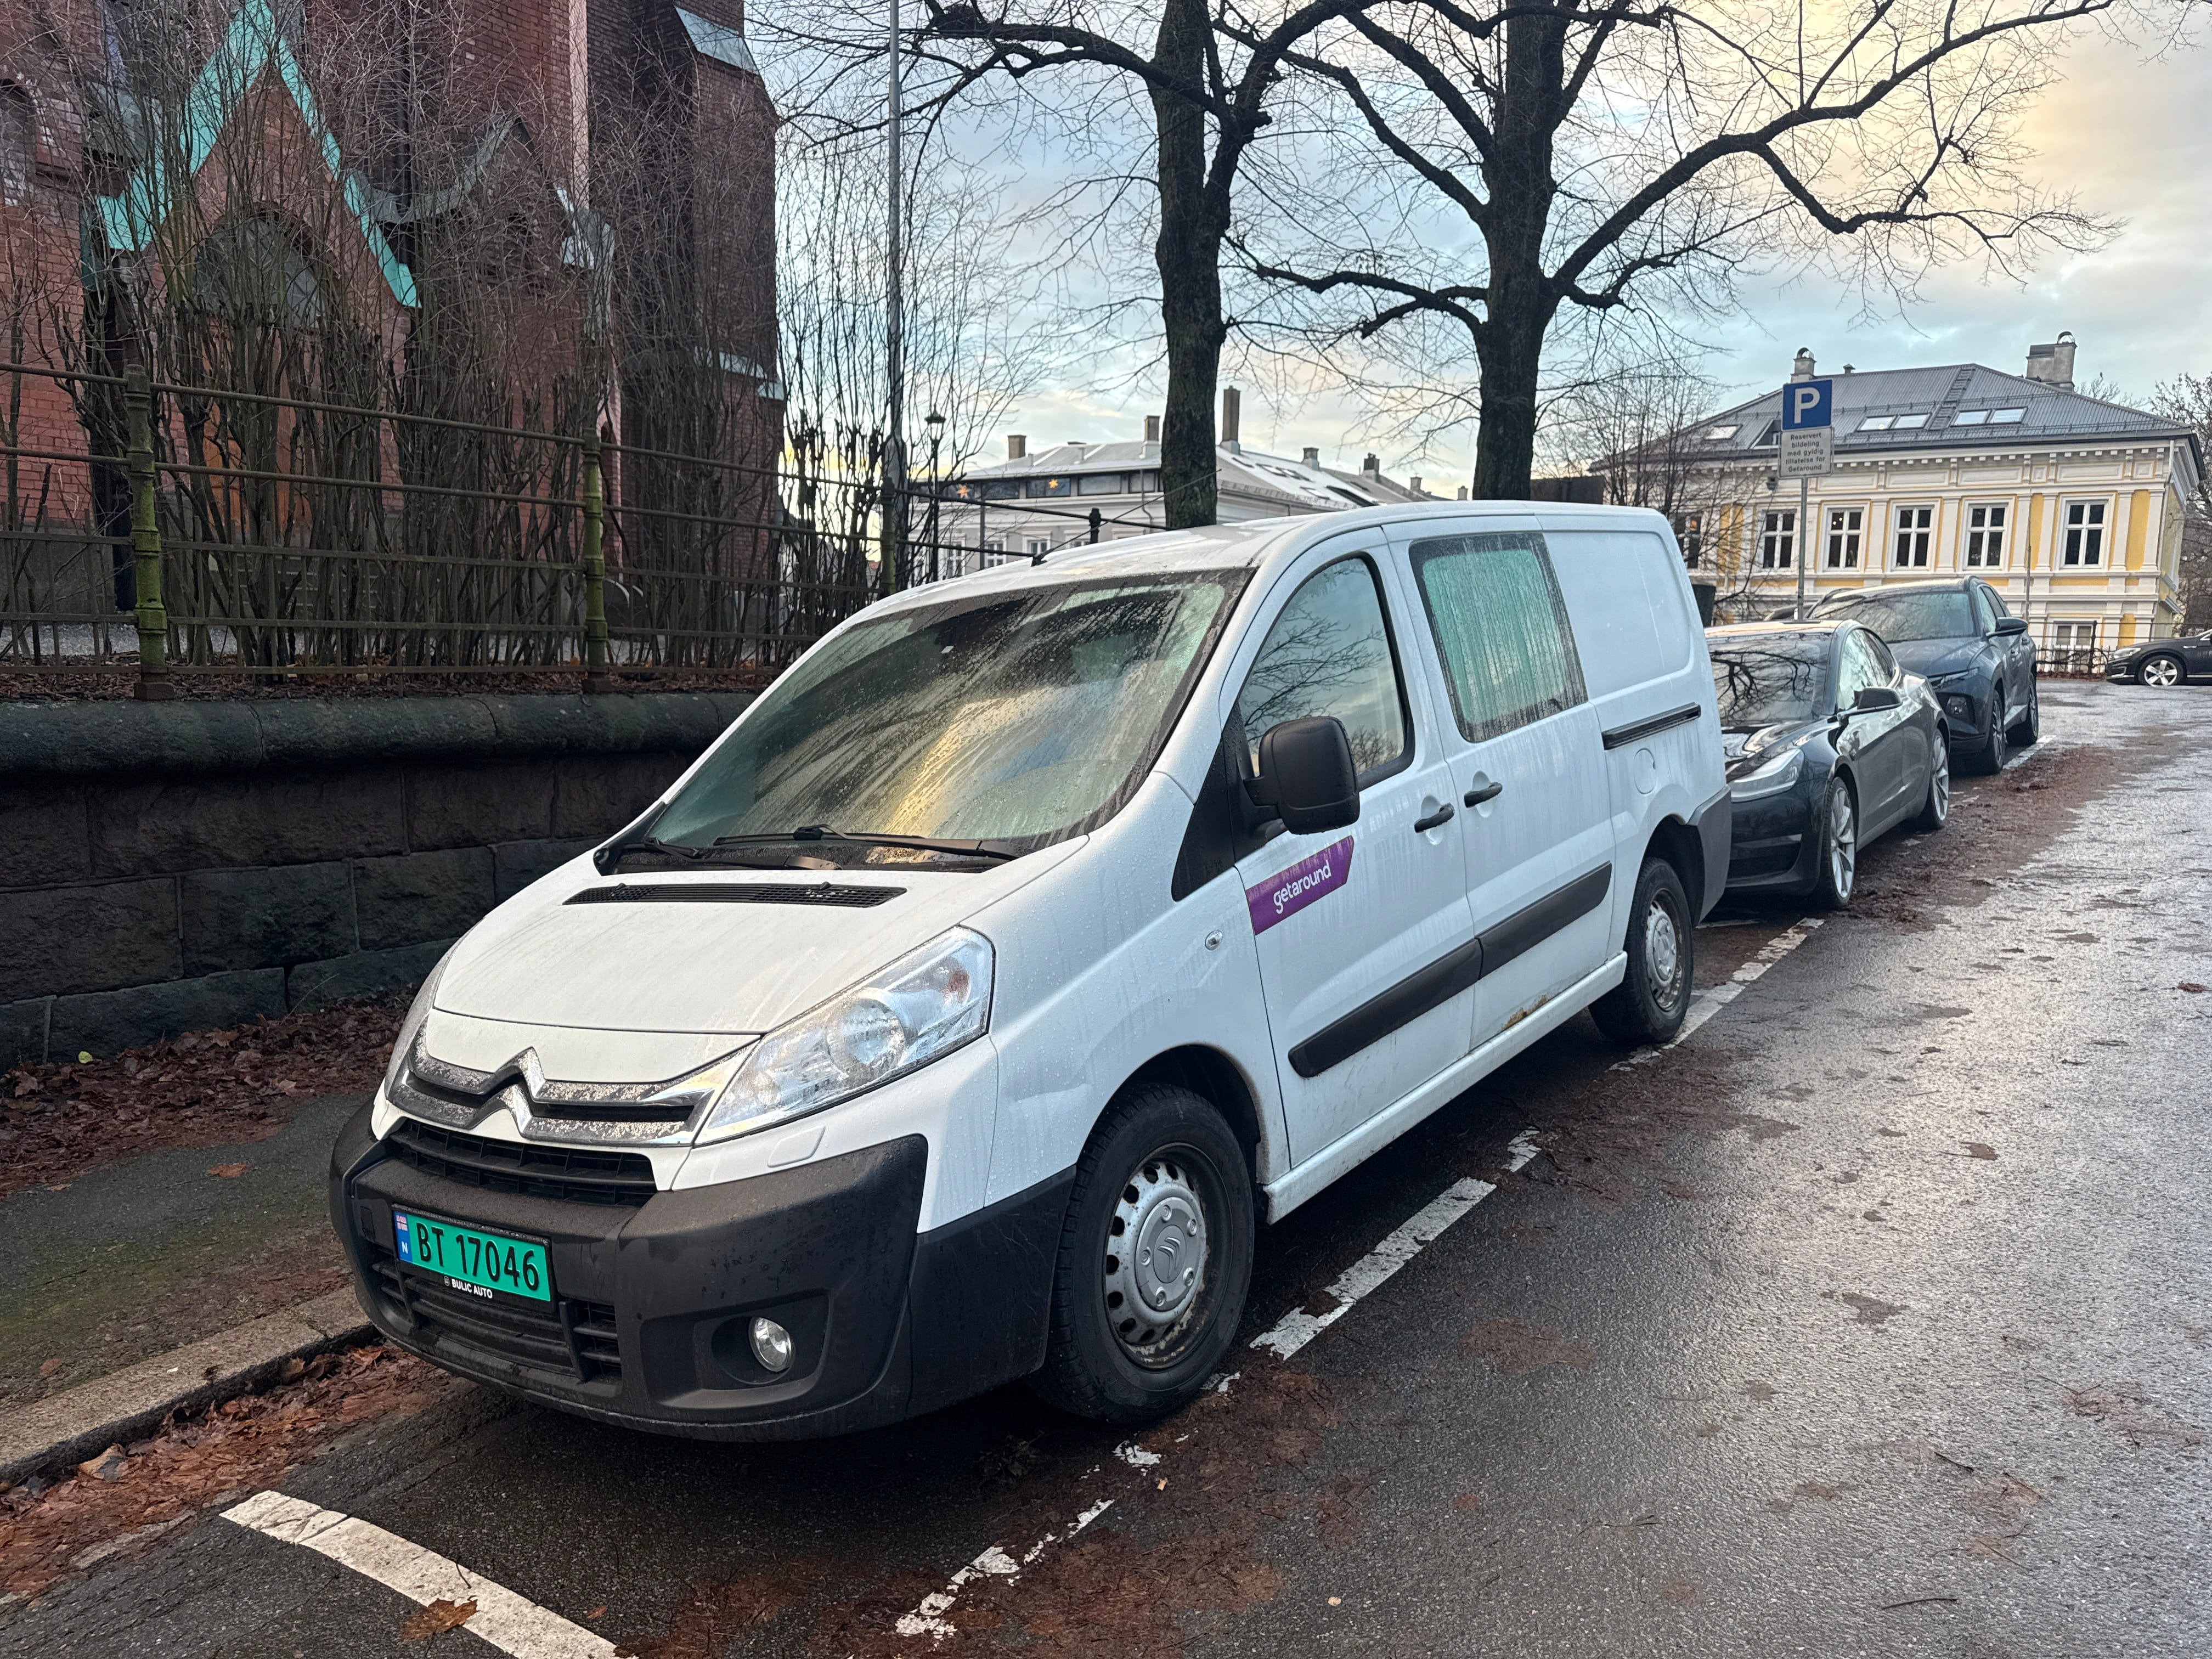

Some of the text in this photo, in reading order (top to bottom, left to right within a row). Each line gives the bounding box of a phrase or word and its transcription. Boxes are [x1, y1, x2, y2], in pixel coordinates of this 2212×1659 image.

[1794, 387, 1820, 424] P
[1791, 432, 1821, 441] Reservert
[1788, 464, 1821, 472] Getaround
[1273, 860, 1331, 914] getaround
[402, 1241, 408, 1254] N
[416, 1222, 539, 1291] BT 17046
[452, 1278, 493, 1299] BULIC AUTO
